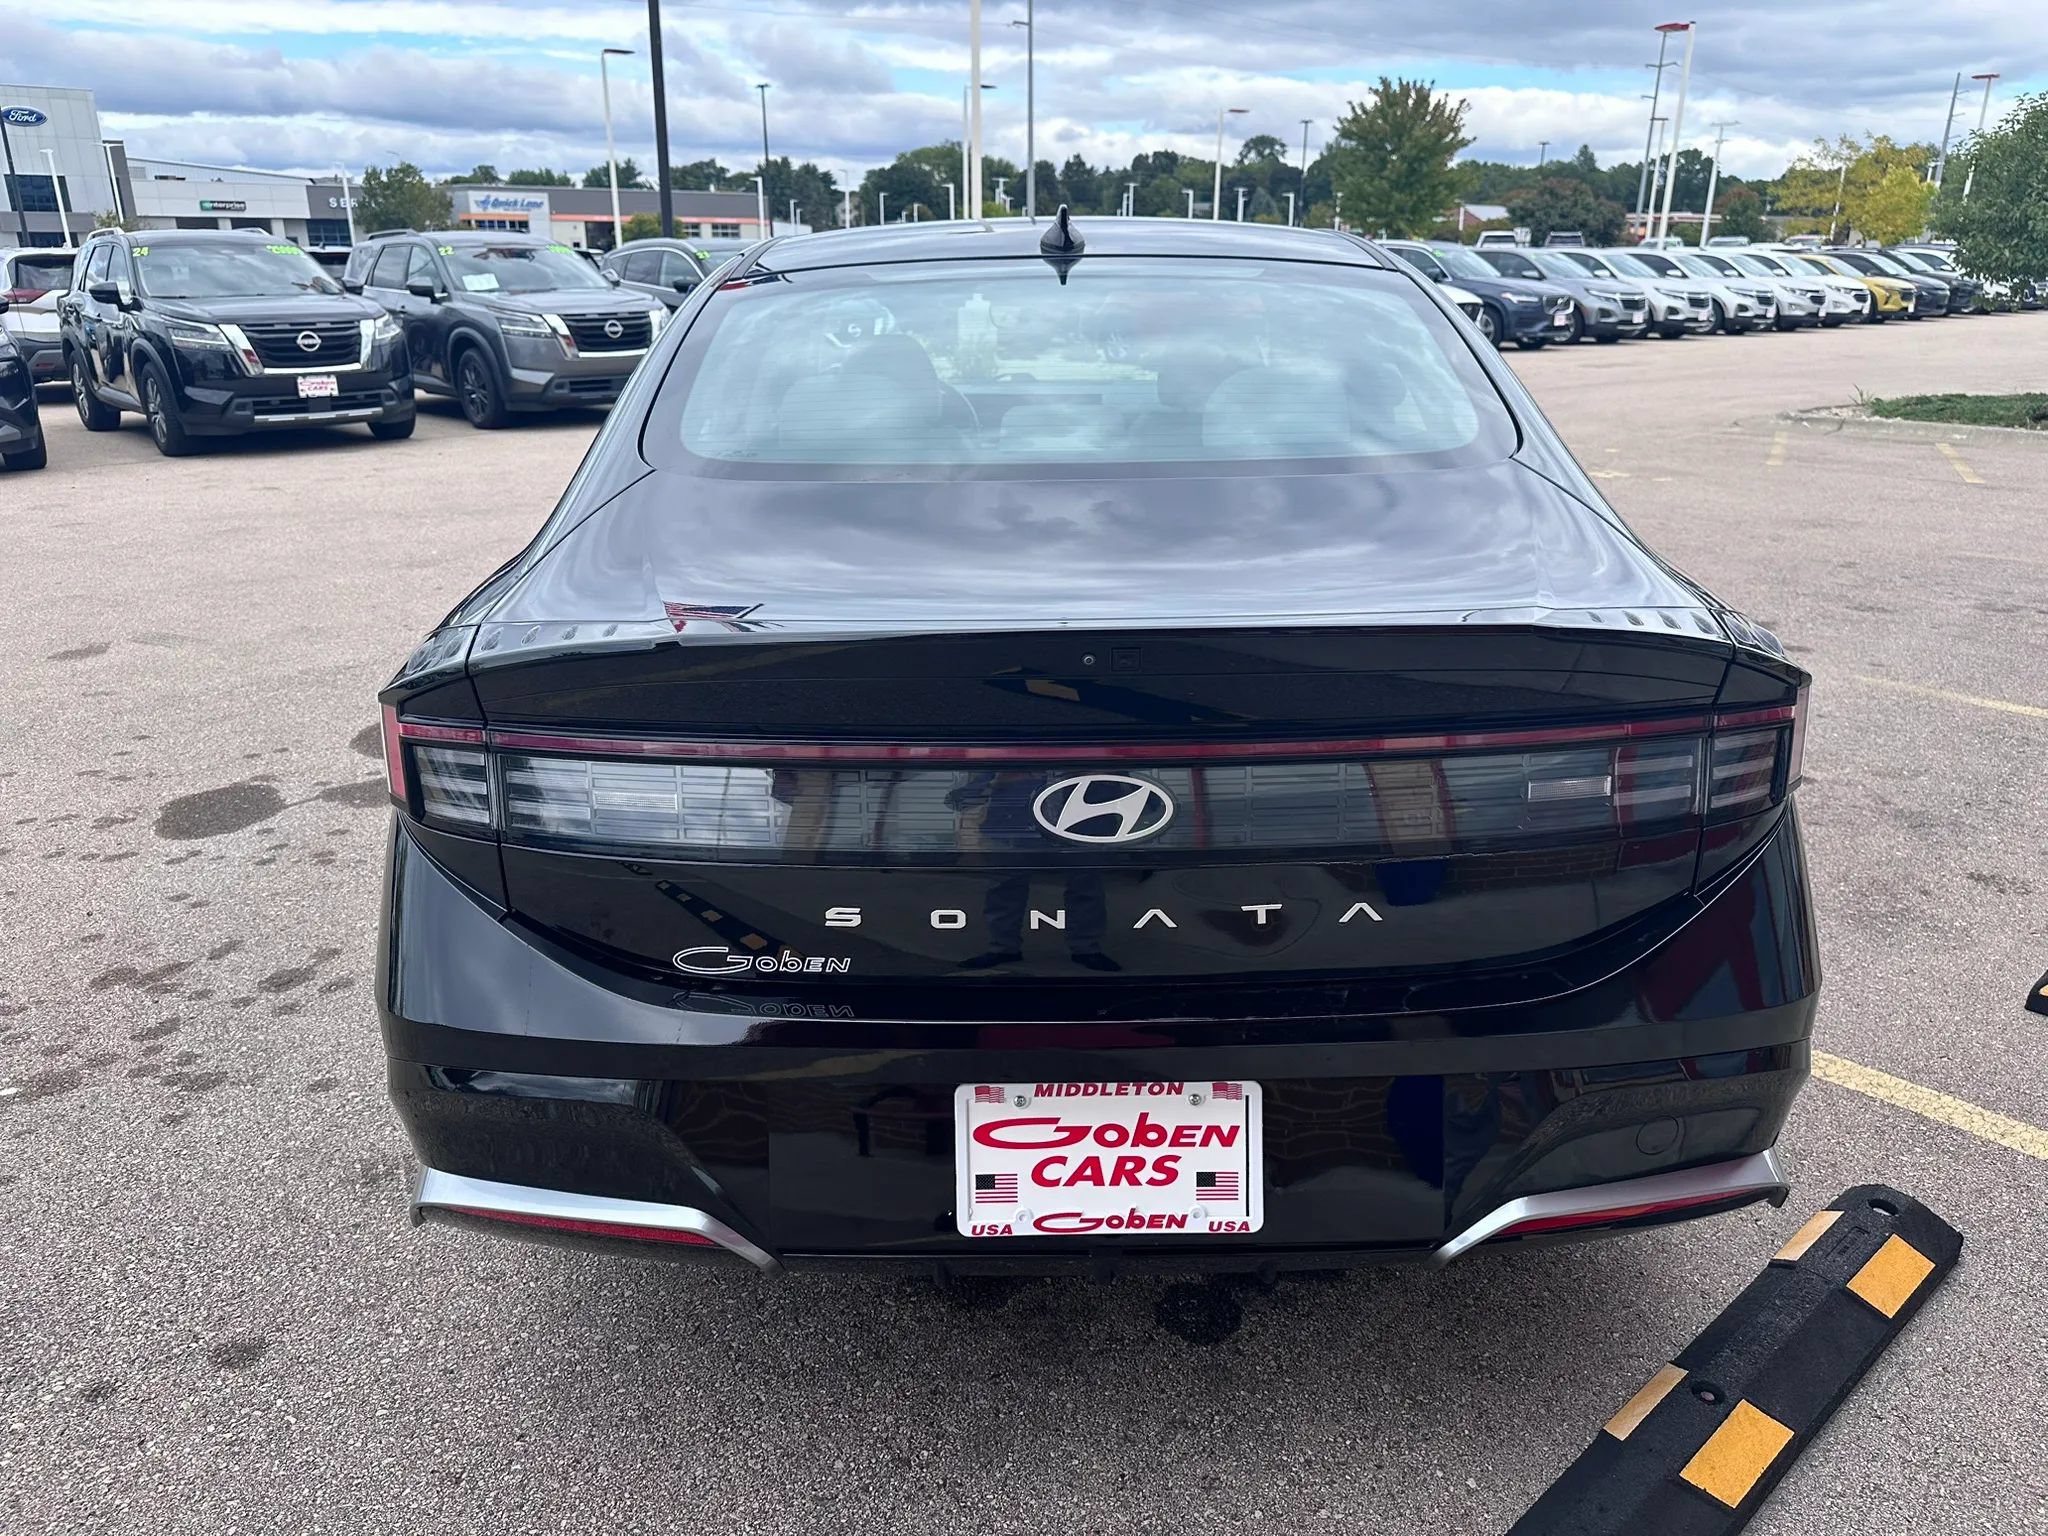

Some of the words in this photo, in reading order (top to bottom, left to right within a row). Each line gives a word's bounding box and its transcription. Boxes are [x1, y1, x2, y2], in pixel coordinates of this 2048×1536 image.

[9, 110, 37, 122] Ford
[491, 198, 518, 208] Quick
[520, 198, 544, 208] Lane
[132, 247, 149, 257] 24
[438, 246, 455, 256] 22
[824, 902, 1383, 930] SONATA
[1034, 1082, 1184, 1098] MIDDLETON
[1030, 1155, 1182, 1188] CARS
[971, 1224, 1013, 1236] USA
[1208, 1220, 1251, 1232] USA
